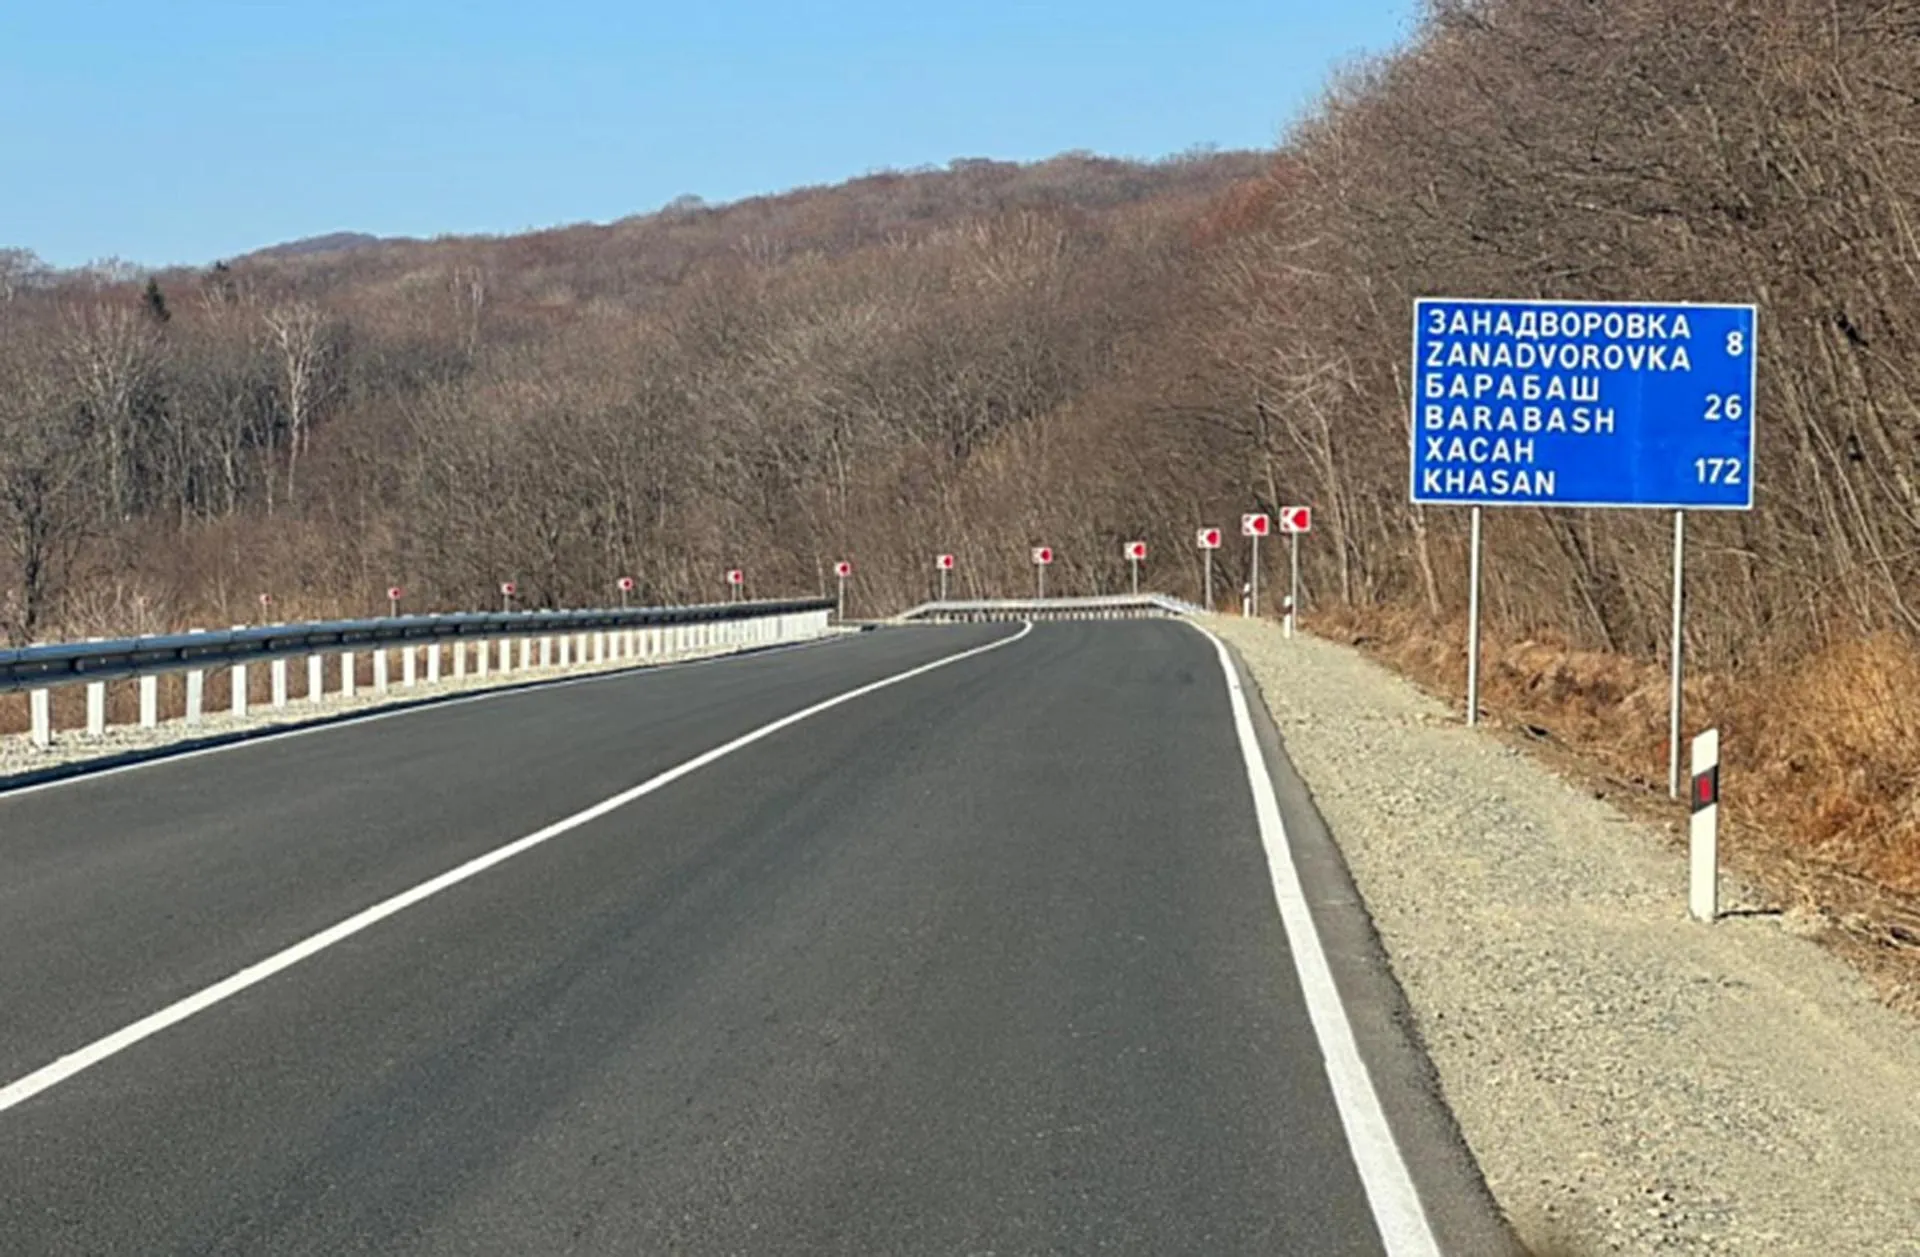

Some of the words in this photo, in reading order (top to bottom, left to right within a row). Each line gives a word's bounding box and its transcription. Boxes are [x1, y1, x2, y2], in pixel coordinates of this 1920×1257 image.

[1429, 310, 1689, 339] ЗАНАДВОРОВКА
[1427, 342, 1689, 370] ZANADVOROVKA
[1727, 332, 1743, 355] 8
[1426, 374, 1598, 401] БАРАБАШ
[1426, 406, 1613, 432] BARABASH
[1705, 395, 1741, 420] 26
[1427, 437, 1533, 462] ХАСАН
[1424, 469, 1554, 495] KHASAN
[1696, 459, 1740, 483] 172
